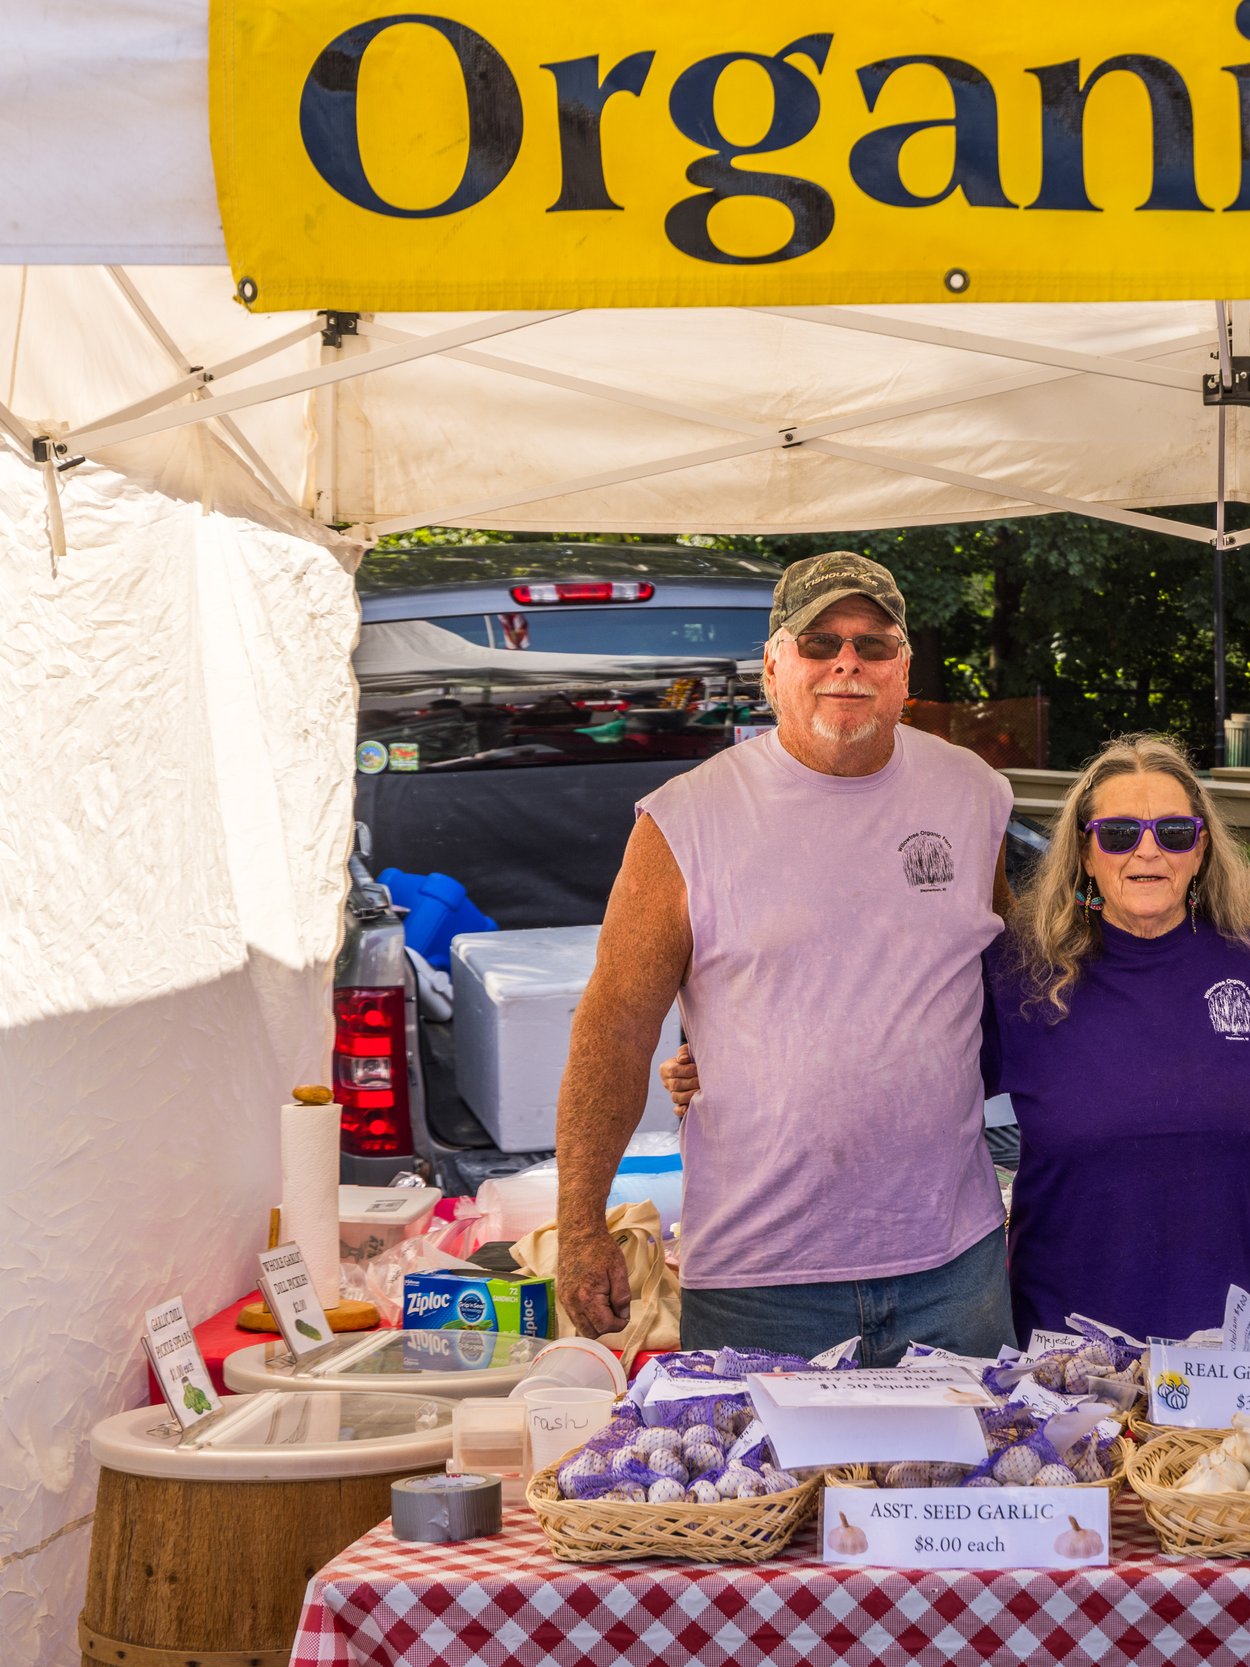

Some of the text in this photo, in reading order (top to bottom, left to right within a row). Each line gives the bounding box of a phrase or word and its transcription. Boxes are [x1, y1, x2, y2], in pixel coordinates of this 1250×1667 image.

[920, 830, 942, 838] Organic
[942, 836, 952, 849] Farm
[1226, 979, 1246, 988] Organic
[262, 1257, 285, 1273] WHOLE
[273, 1281, 289, 1295] DILL
[509, 1287, 518, 1295] 72
[407, 1292, 450, 1316] Ziploc
[1034, 1333, 1077, 1348] Majestic
[1184, 1362, 1229, 1379] REAL
[528, 1406, 588, 1431] Trash
[870, 1502, 1054, 1520] ASST. SEED GARLIC
[914, 1535, 1005, 1553] $8.00 each
